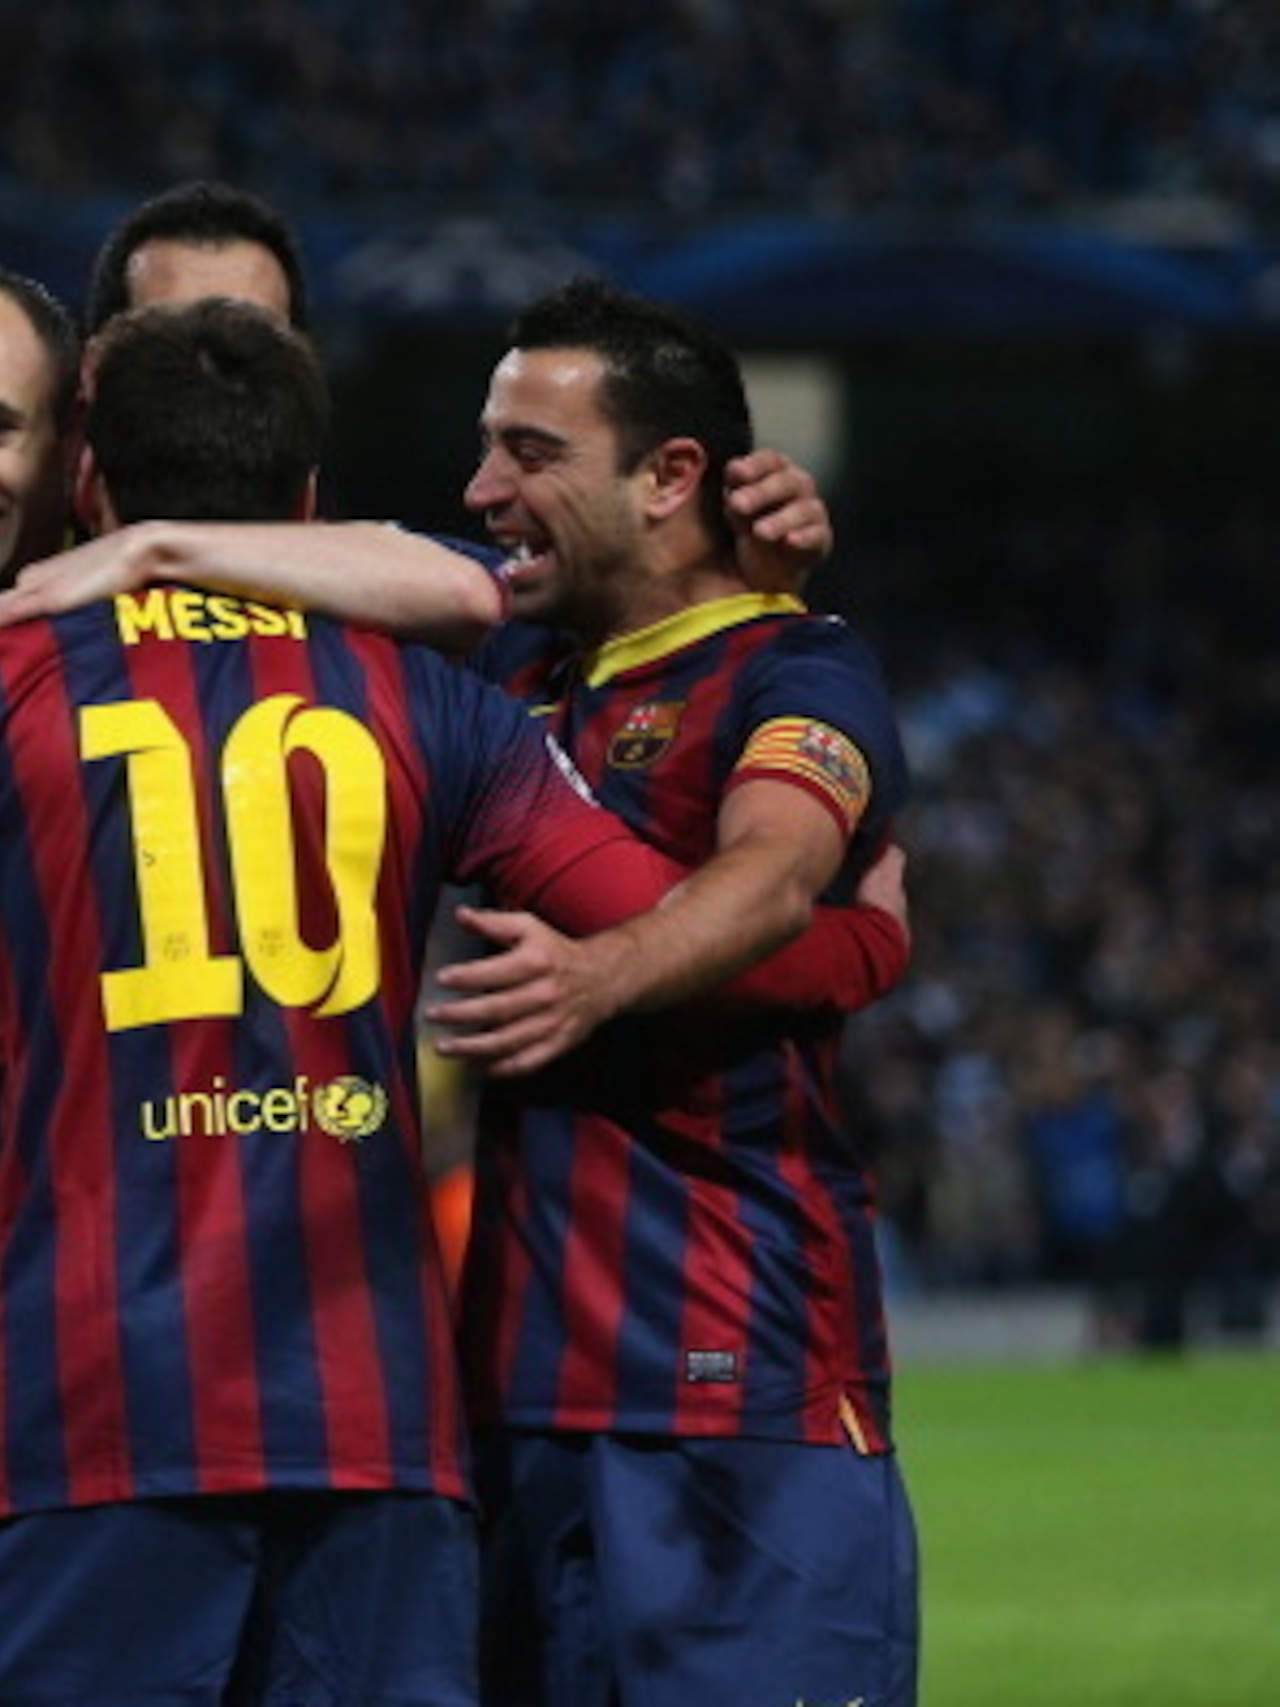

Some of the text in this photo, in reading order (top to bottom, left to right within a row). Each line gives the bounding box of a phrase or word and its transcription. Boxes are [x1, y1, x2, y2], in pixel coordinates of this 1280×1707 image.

[115, 588, 307, 645] MESSI
[79, 693, 386, 1033] 10
[140, 1075, 309, 1141] unicef
